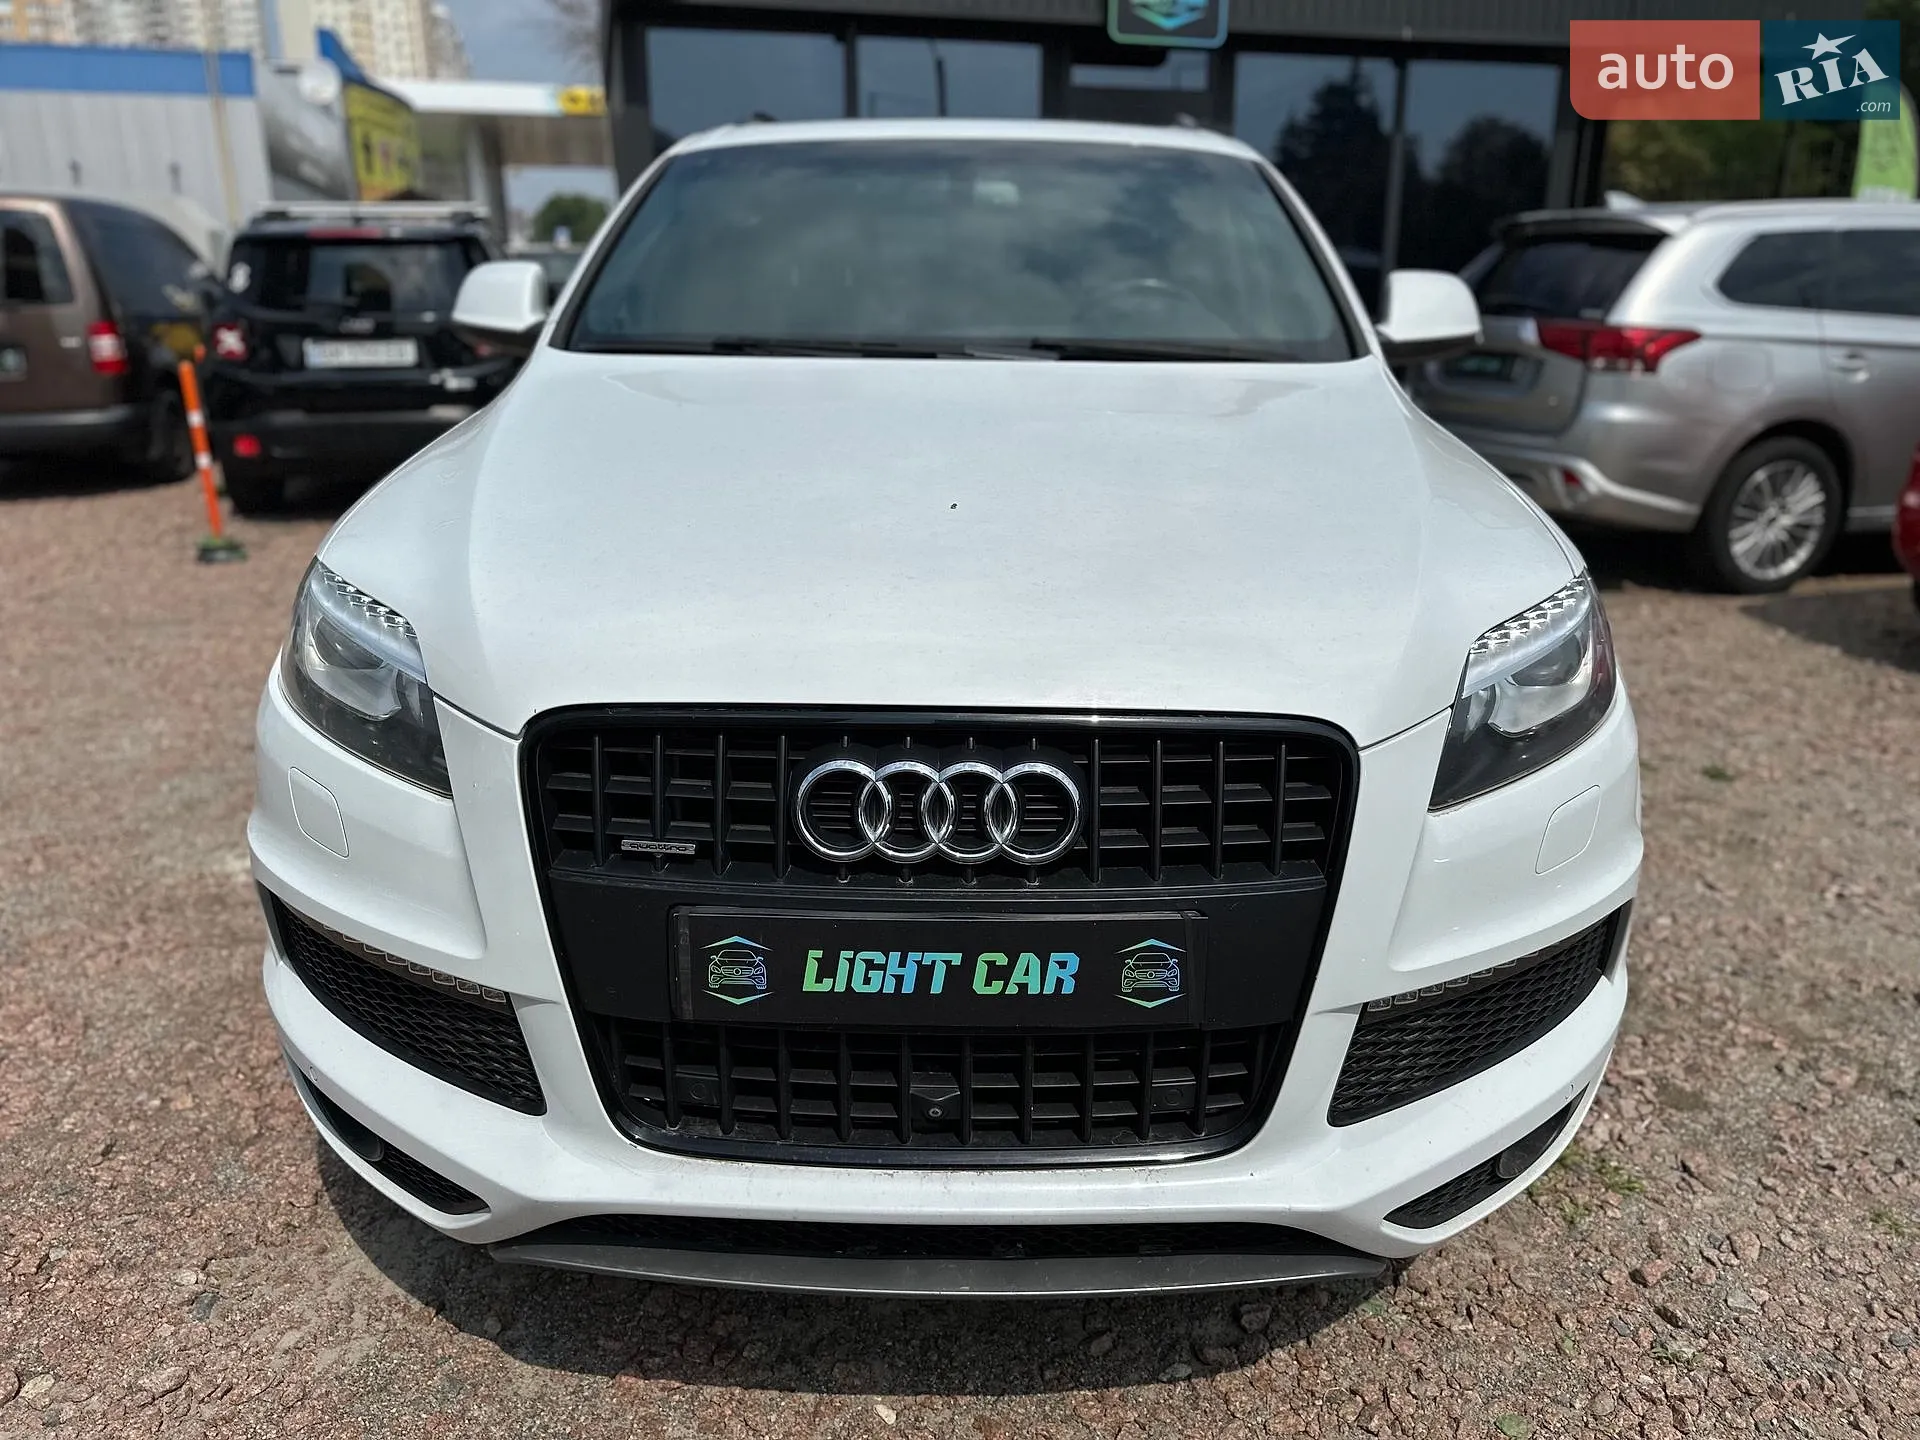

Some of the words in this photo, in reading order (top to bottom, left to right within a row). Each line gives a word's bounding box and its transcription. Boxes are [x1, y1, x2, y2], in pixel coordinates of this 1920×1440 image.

[627, 841, 689, 853] quattro
[802, 949, 963, 995] LIGHT
[972, 952, 1080, 995] CAR
